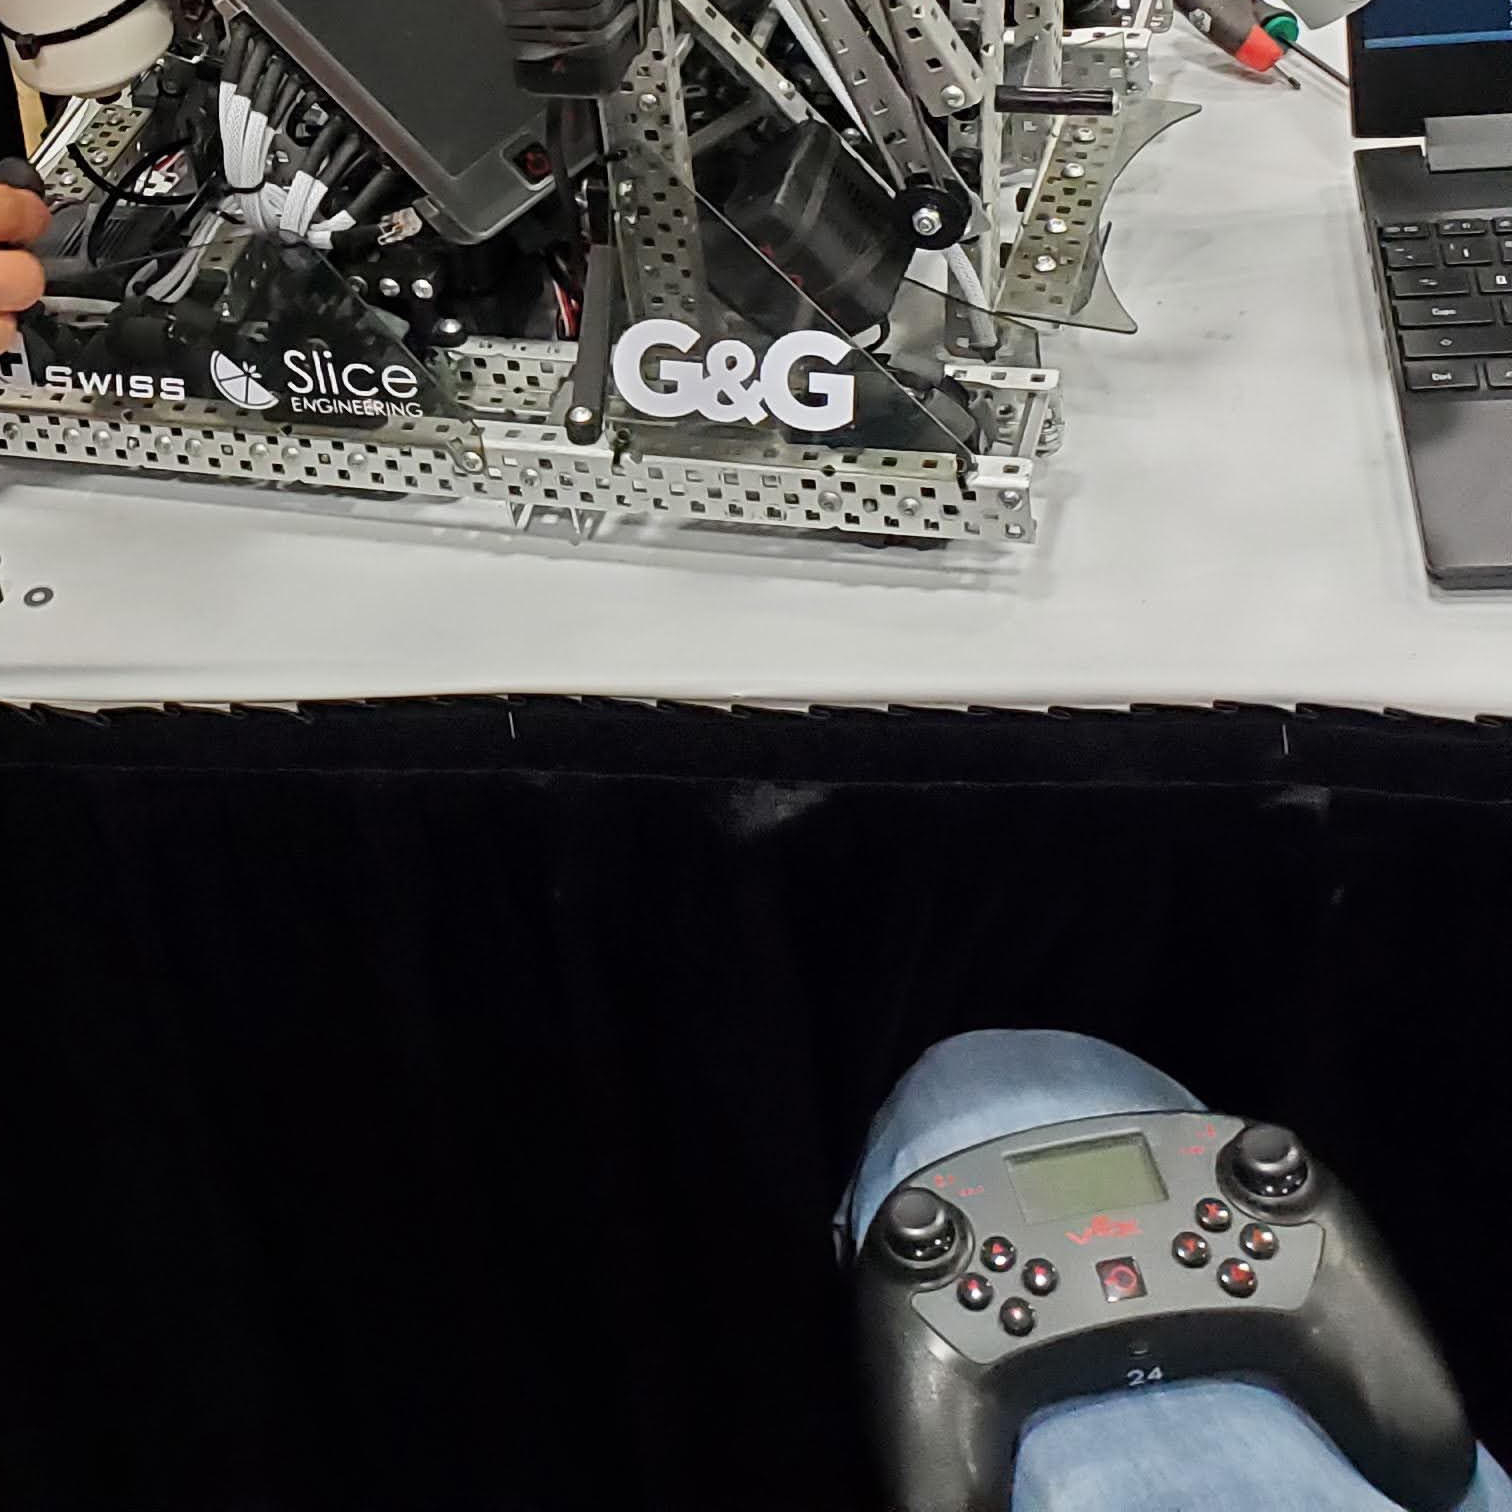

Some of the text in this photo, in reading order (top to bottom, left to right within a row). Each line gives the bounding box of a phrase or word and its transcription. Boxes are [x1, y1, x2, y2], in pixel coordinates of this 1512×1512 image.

[283, 349, 419, 399] Slice
[613, 319, 855, 432] G&G
[291, 396, 424, 419] ENGINEERING
[1127, 1366, 1163, 1386] 24
